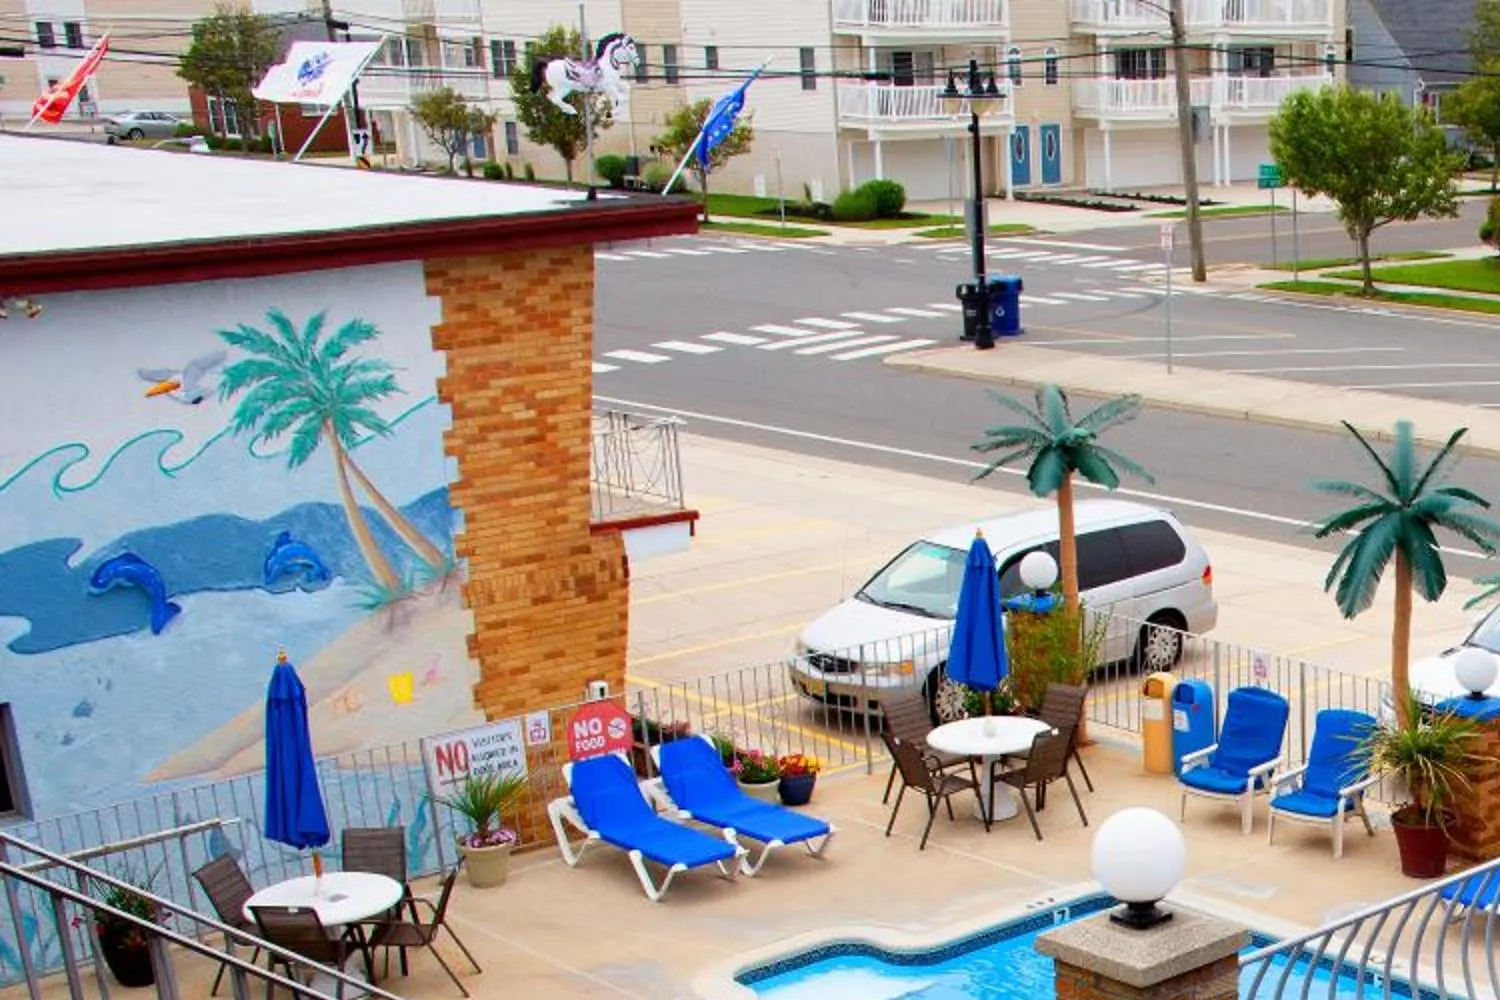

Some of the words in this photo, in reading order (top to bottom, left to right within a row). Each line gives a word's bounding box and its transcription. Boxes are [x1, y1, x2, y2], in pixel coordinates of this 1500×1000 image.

[573, 717, 603, 739] NO
[575, 736, 606, 753] FOOD
[434, 738, 469, 777] NO
